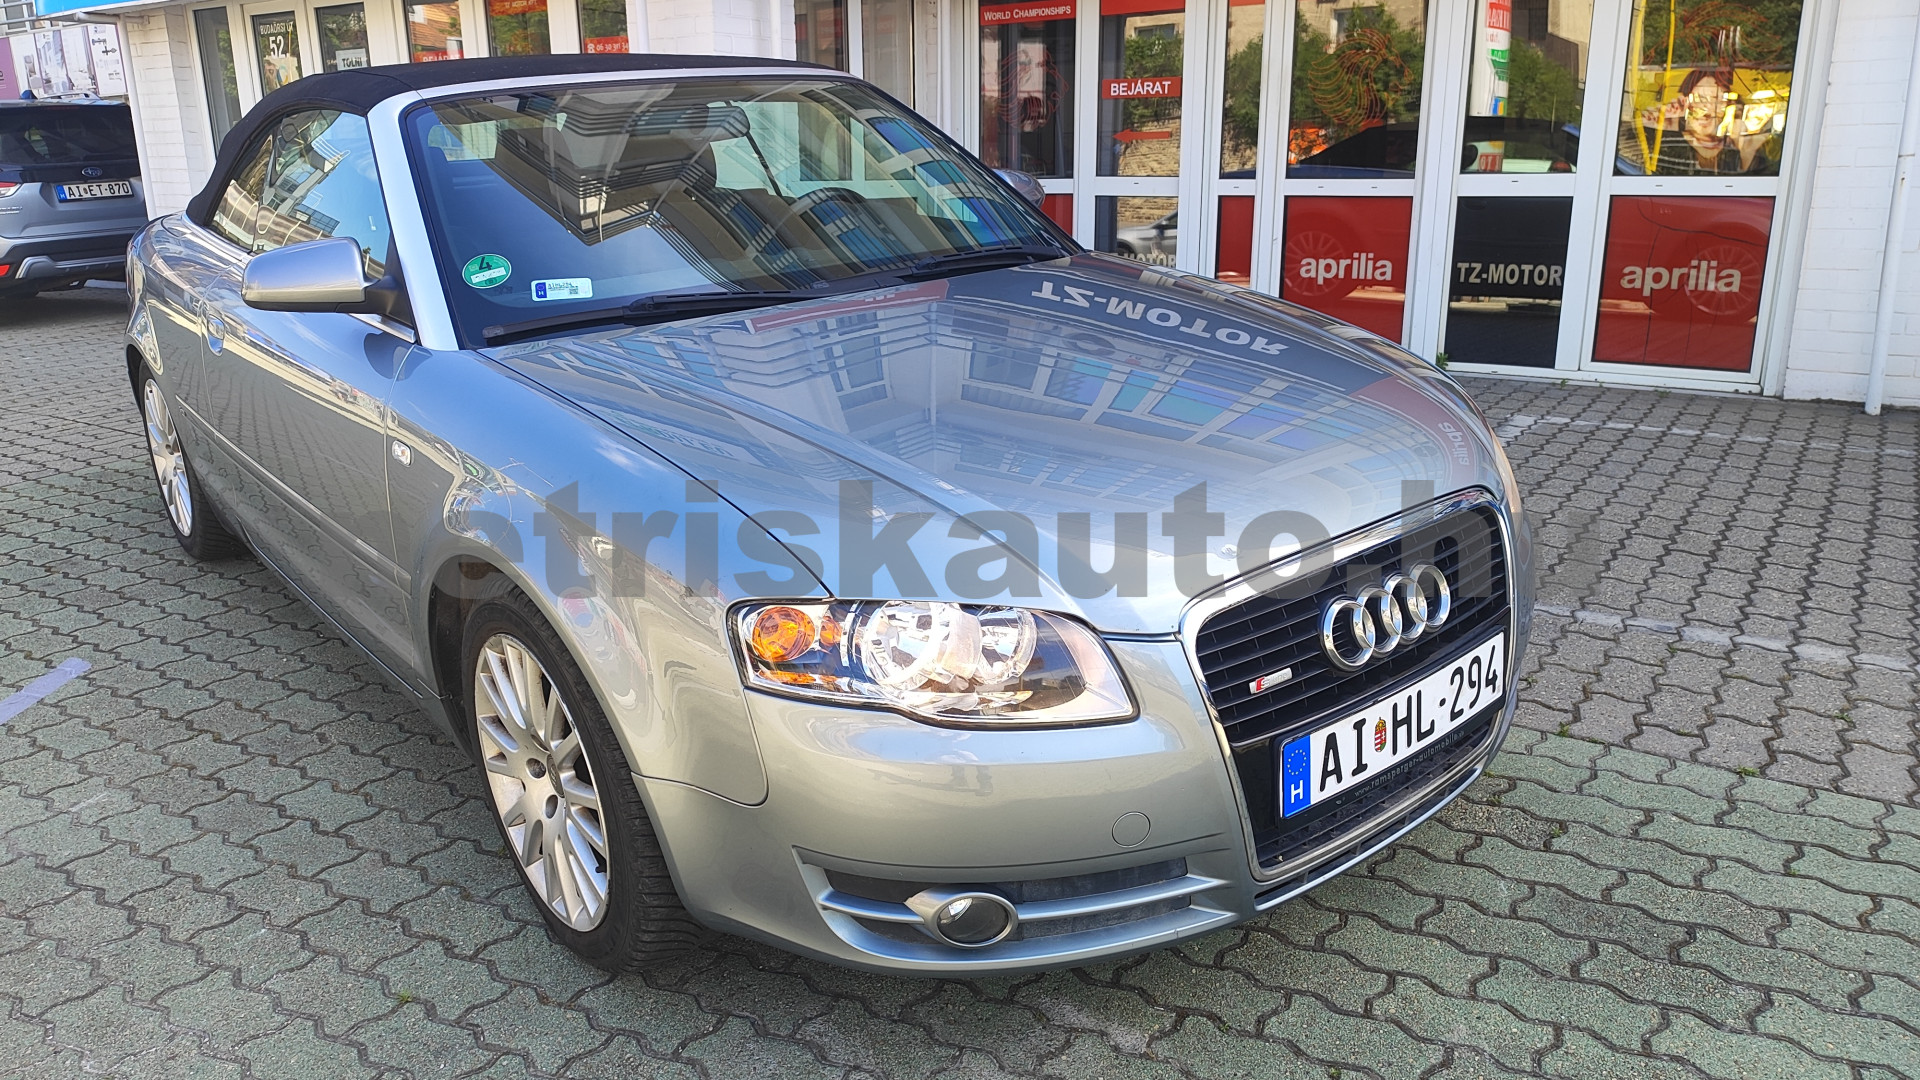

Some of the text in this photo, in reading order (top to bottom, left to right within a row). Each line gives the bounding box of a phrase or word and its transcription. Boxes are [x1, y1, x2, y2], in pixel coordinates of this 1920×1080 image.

[984, 5, 1071, 21] WORLD CHAMPIONSHIPS
[1110, 79, 1171, 96] BEJÁRAT
[68, 186, 84, 199] AI
[479, 256, 492, 270] 4
[1299, 252, 1392, 285] aprilia
[1457, 262, 1562, 286] TZ-MOTOR
[1620, 260, 1741, 296] aprilia
[1319, 717, 1368, 792] AI
[1290, 780, 1304, 804] H
